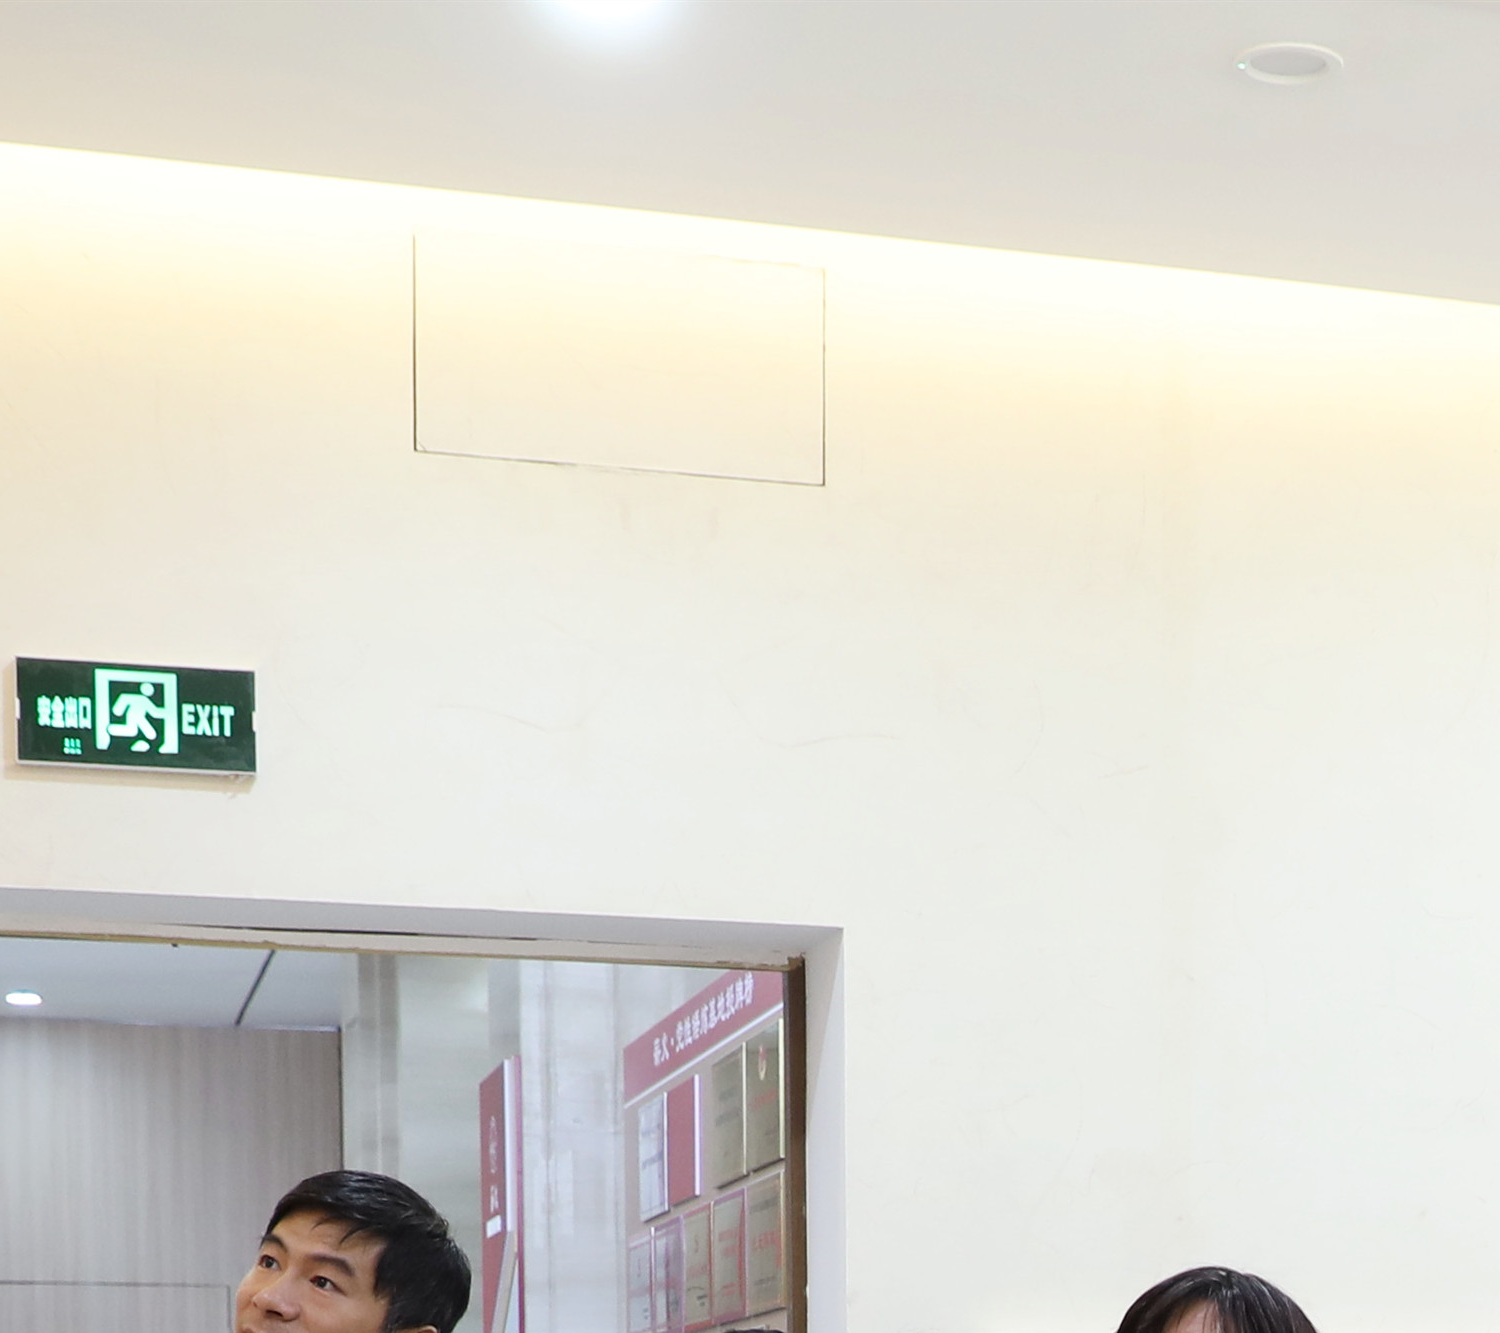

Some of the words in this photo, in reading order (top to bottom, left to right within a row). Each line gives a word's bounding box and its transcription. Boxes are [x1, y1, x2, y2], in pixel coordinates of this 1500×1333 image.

[37, 695, 92, 729] 安全出口
[182, 703, 235, 738] EXIT
